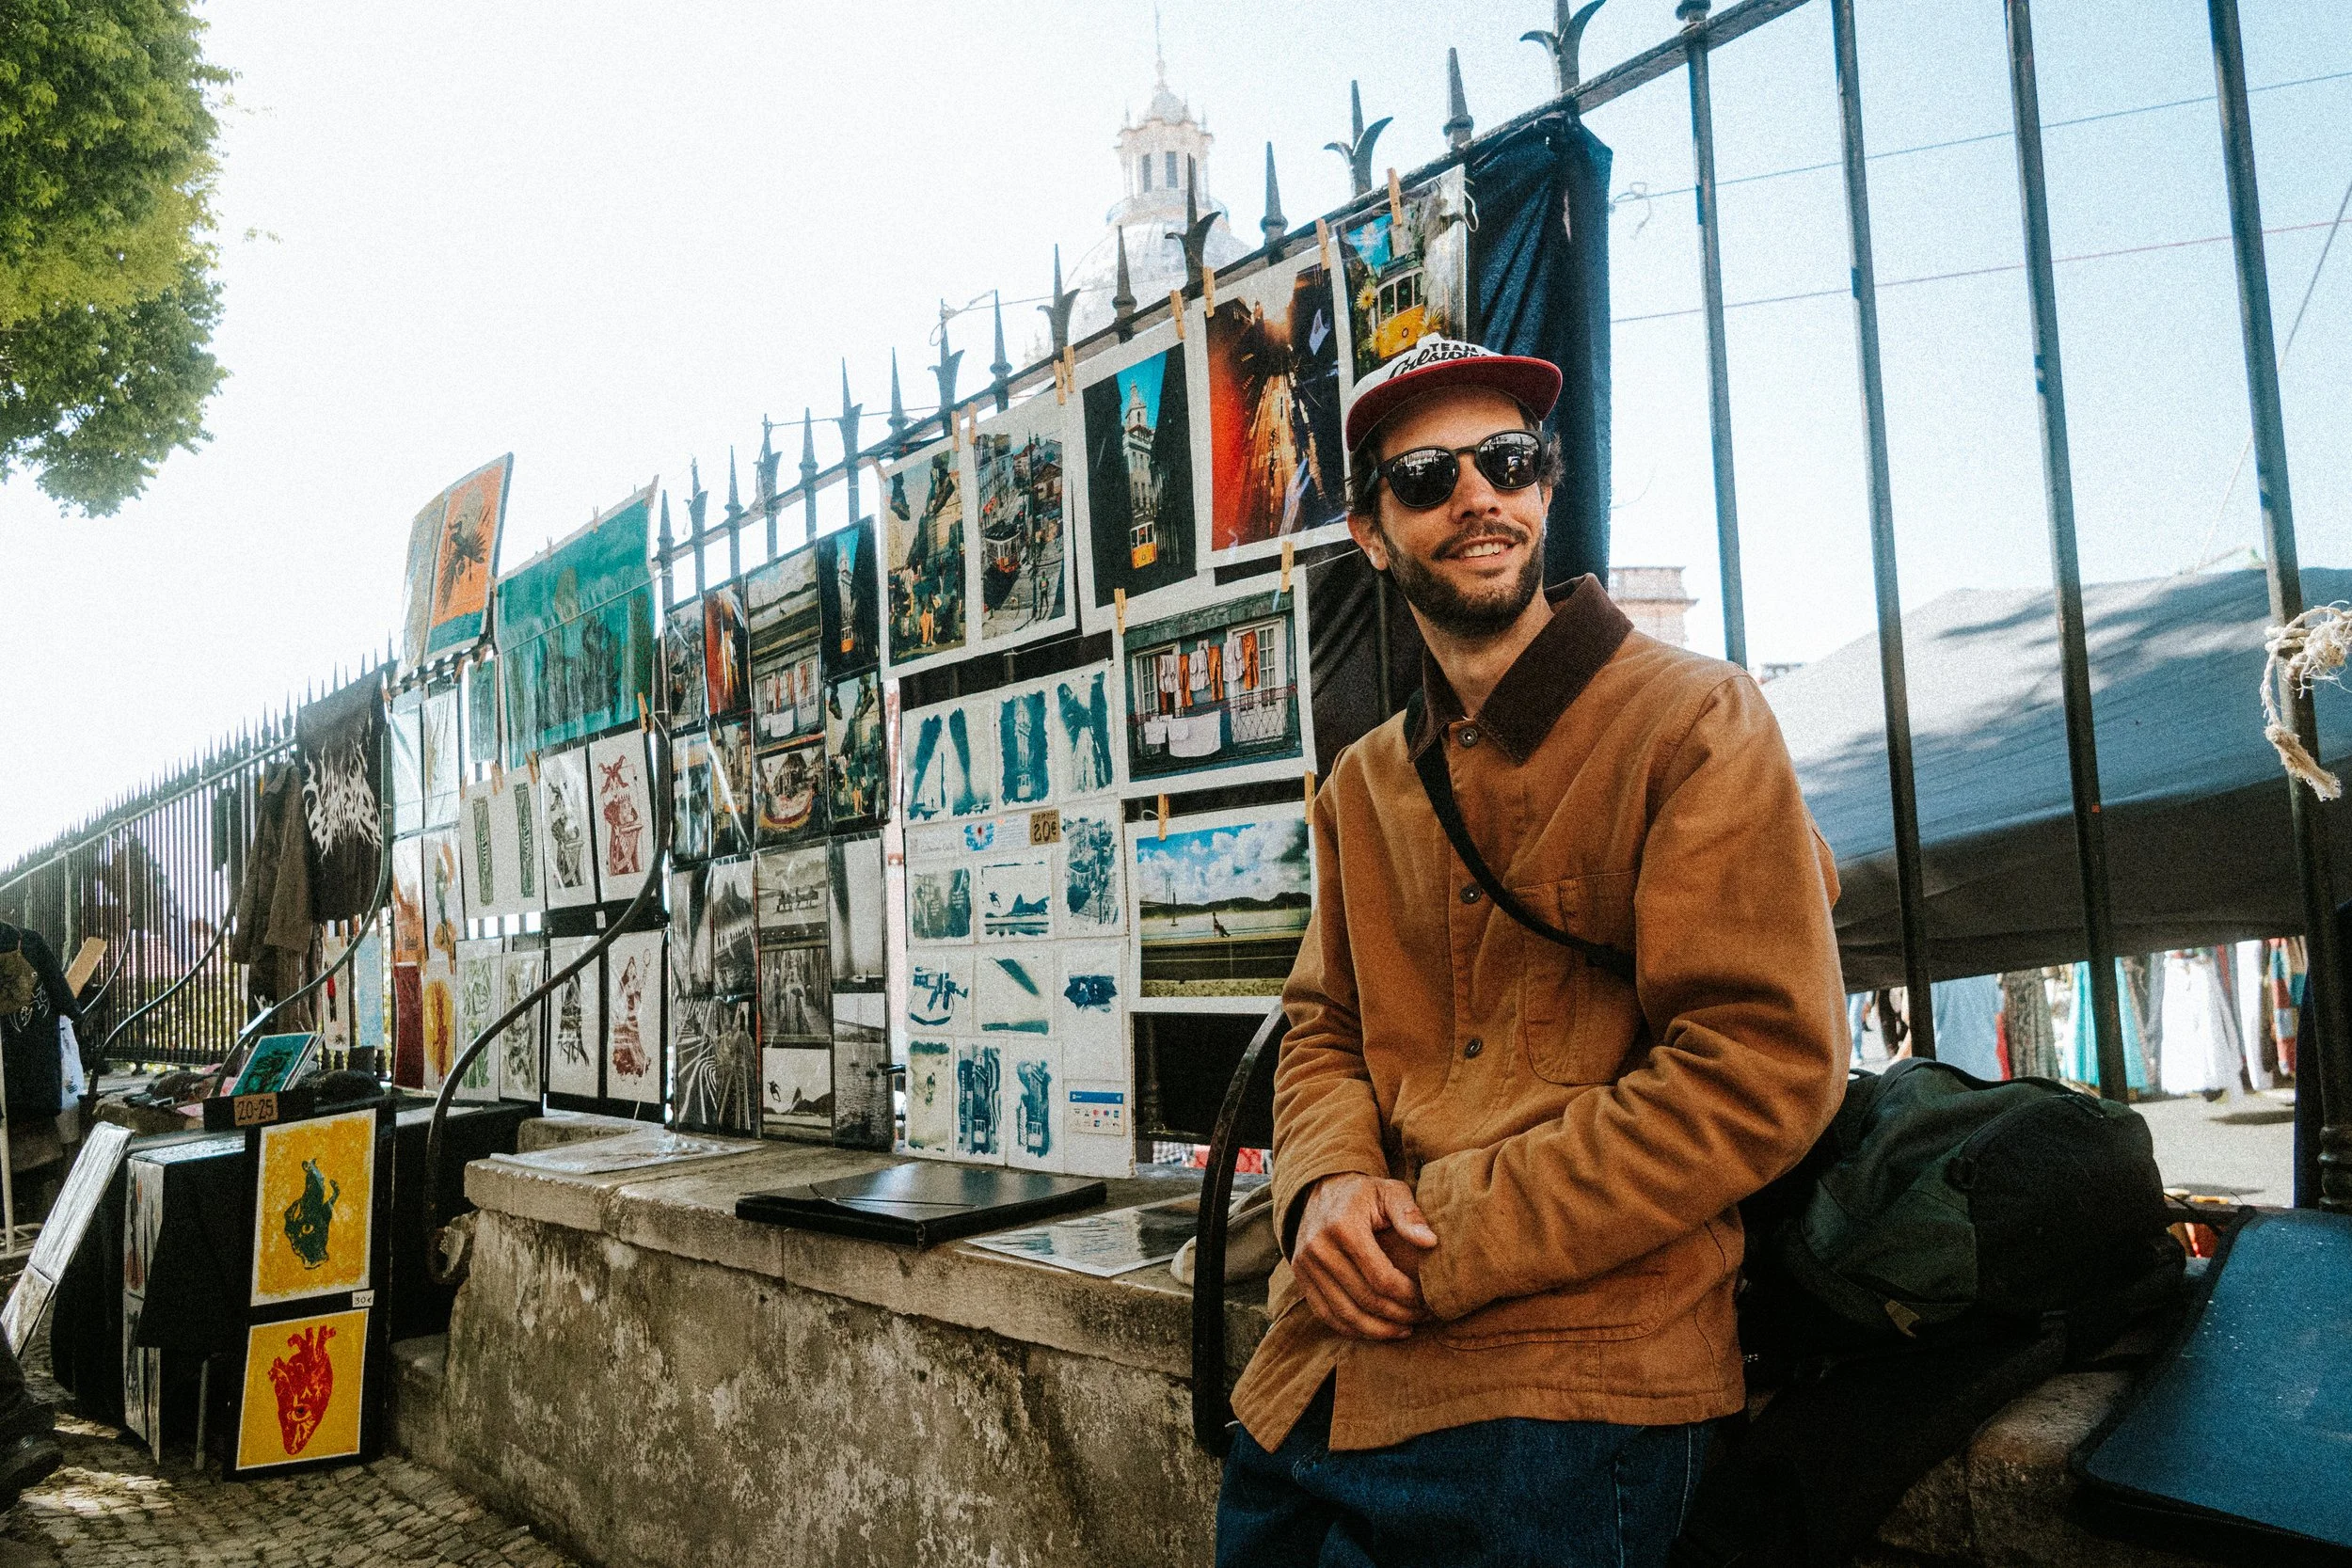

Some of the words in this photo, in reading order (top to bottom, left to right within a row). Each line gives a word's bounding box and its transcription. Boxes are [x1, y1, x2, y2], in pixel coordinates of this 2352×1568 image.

[1429, 342, 1477, 354] TEAM
[1034, 821, 1057, 842] 20€
[237, 1099, 274, 1121] 20-25
